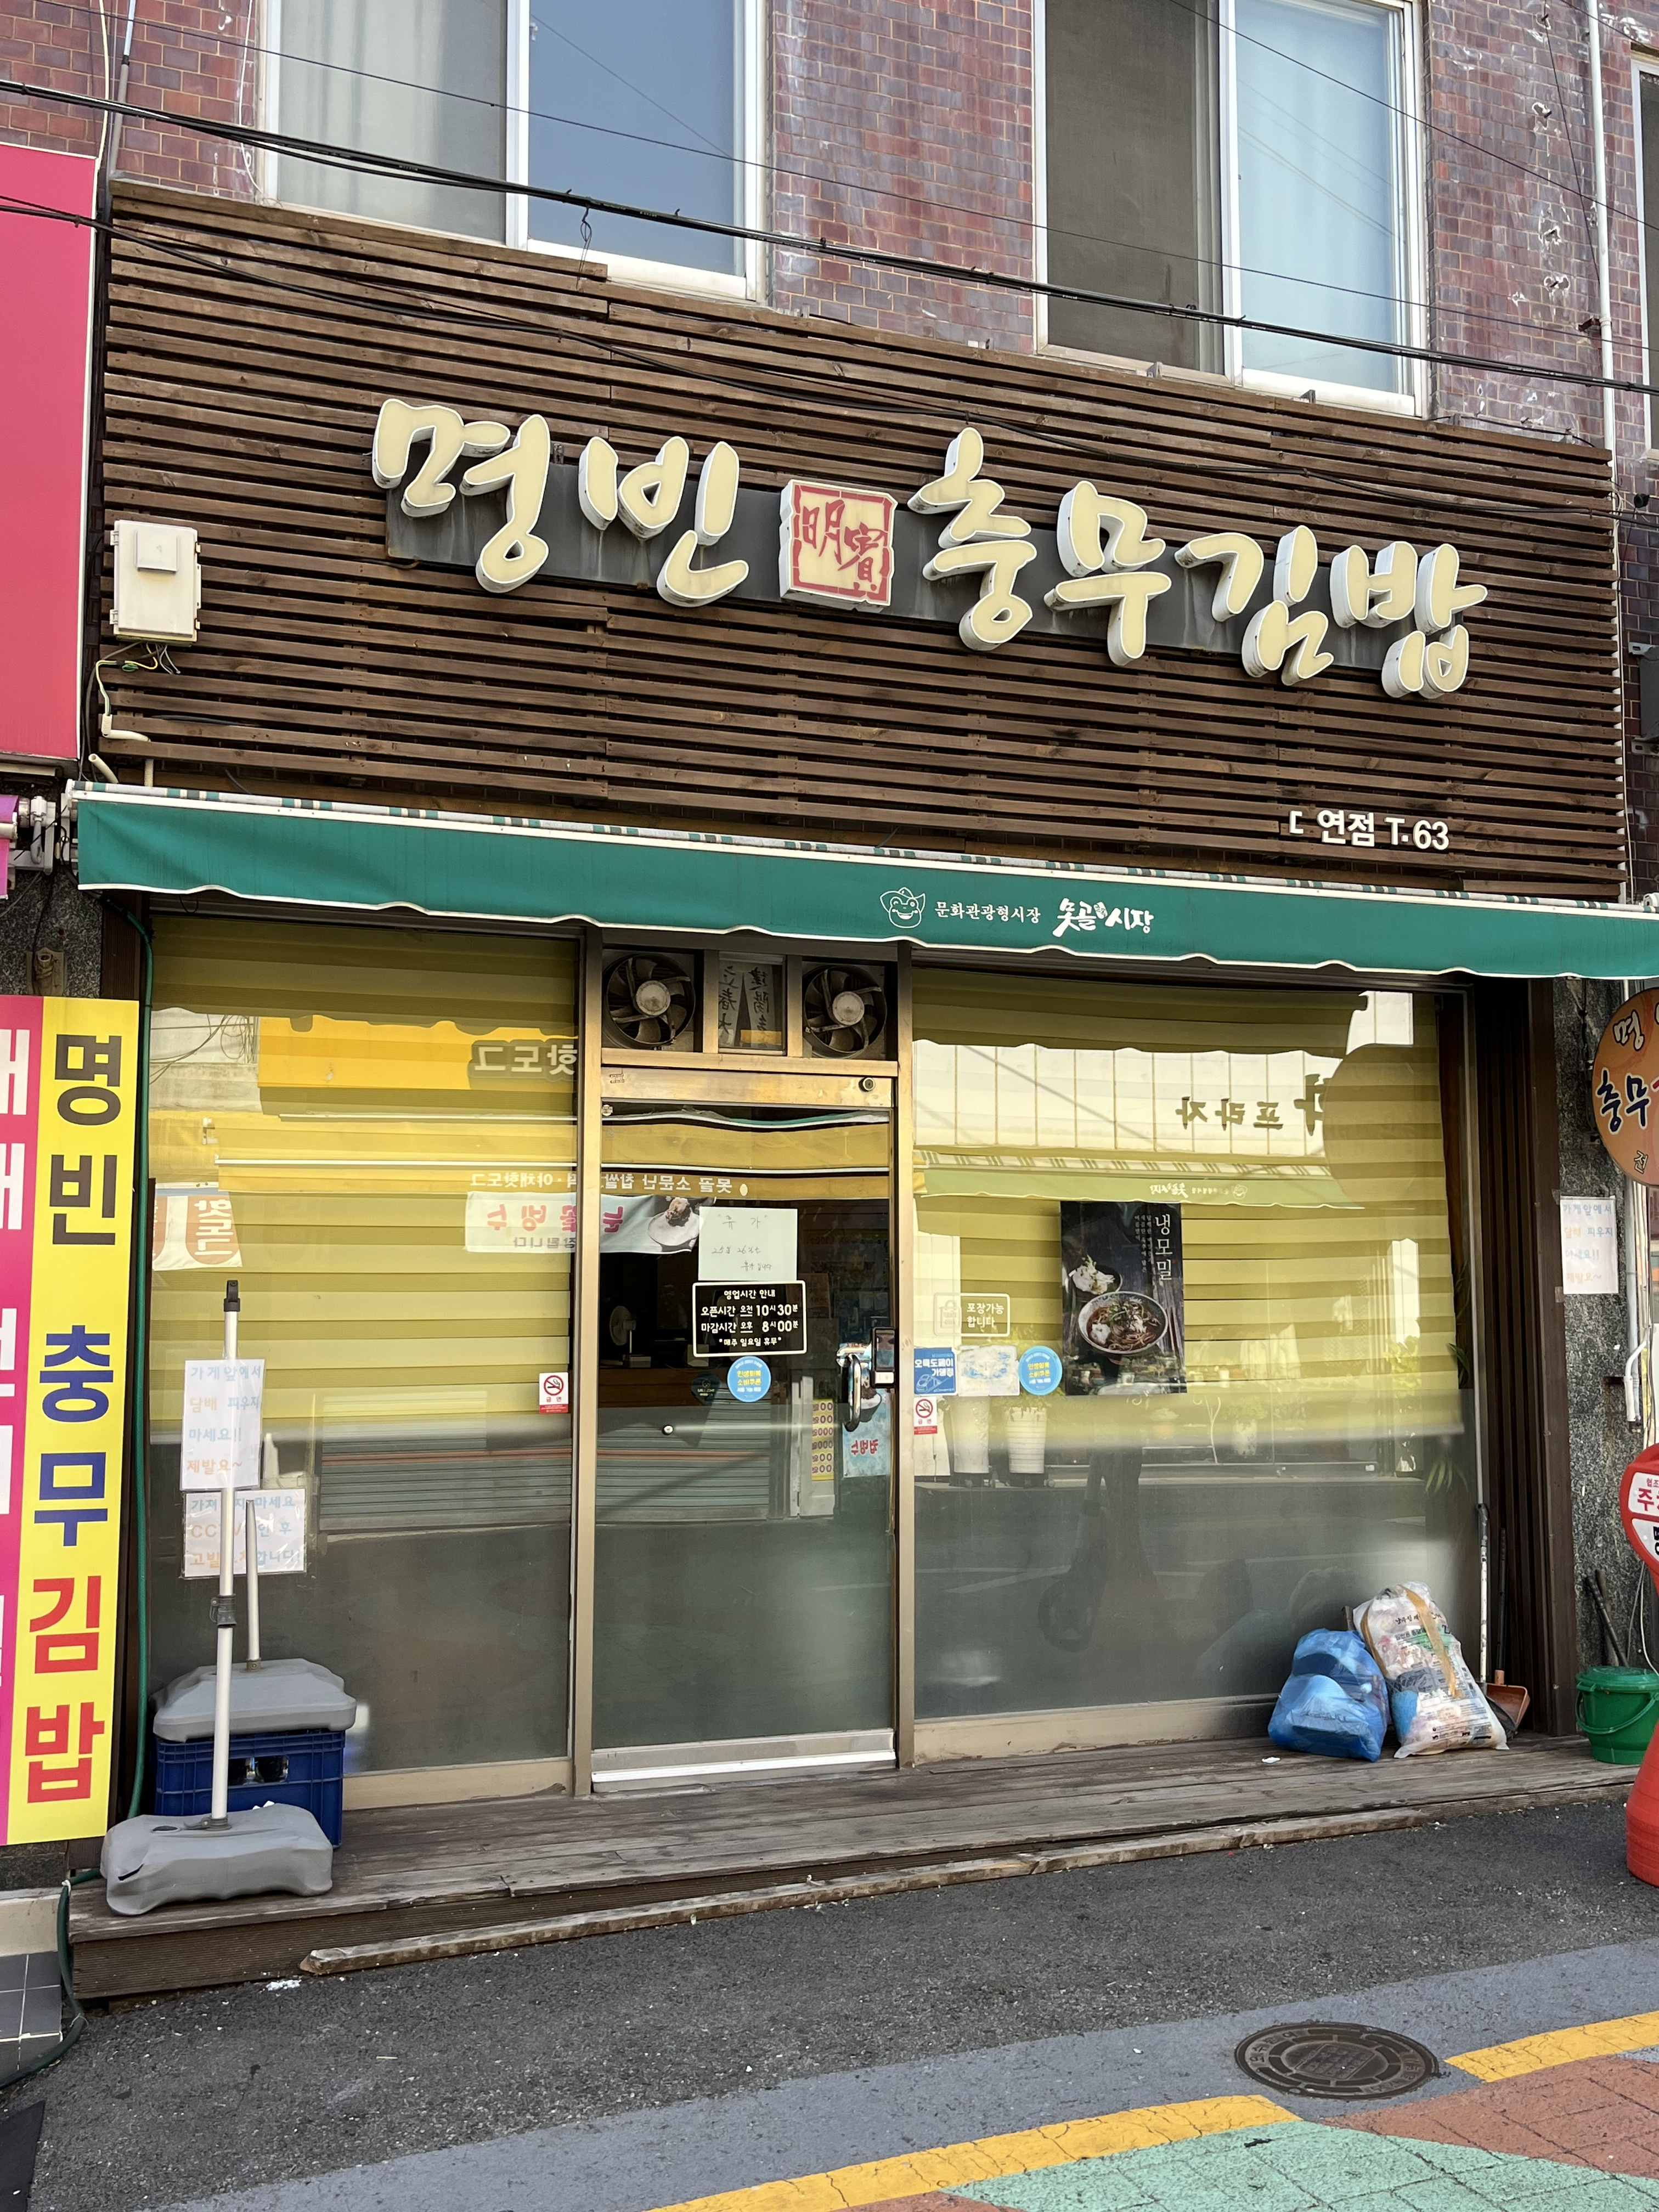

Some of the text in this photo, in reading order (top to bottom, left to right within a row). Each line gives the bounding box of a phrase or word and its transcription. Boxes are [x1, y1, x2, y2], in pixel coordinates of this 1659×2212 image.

[371, 398, 749, 607] 명빈
[907, 426, 1488, 698] 충무김밥
[934, 901, 1041, 924] 문화관광형시장
[49, 1034, 122, 1245] 명빈
[1155, 1214, 1173, 1280] 냉모밀
[724, 1289, 776, 1300] 영업시간 안내
[700, 1305, 736, 1318] 오픈시간
[740, 1305, 753, 1314] 오전
[967, 1302, 1005, 1315] 포장가능
[701, 1322, 737, 1334] 마감시간
[740, 1321, 753, 1330] 오후
[967, 1316, 995, 1328] 합니다
[740, 1338, 761, 1347] 일요일
[191, 1365, 262, 1381] 가게앞에서
[189, 1395, 259, 1413] 담배 피우지
